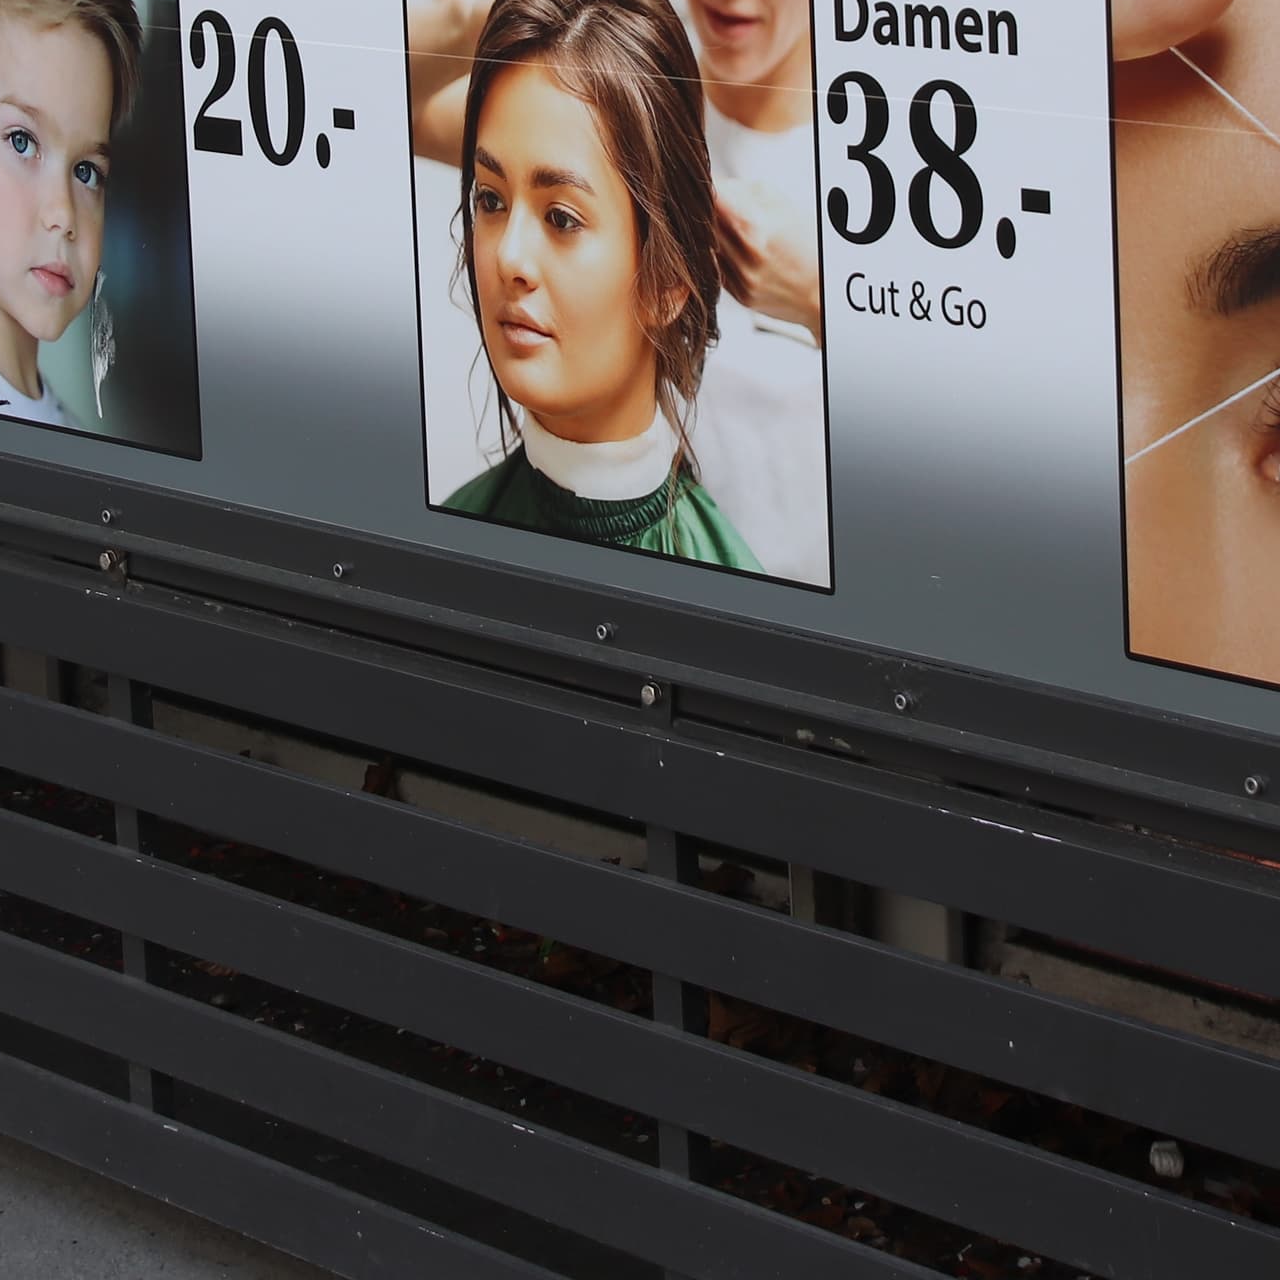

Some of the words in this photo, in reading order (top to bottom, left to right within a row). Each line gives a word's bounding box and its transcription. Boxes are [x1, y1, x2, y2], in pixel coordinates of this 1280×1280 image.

[188, 9, 356, 170] 20.-
[826, 70, 1052, 261] 38.-
[846, 272, 904, 319] Cut
[910, 282, 932, 321] &
[941, 284, 988, 330] Go
